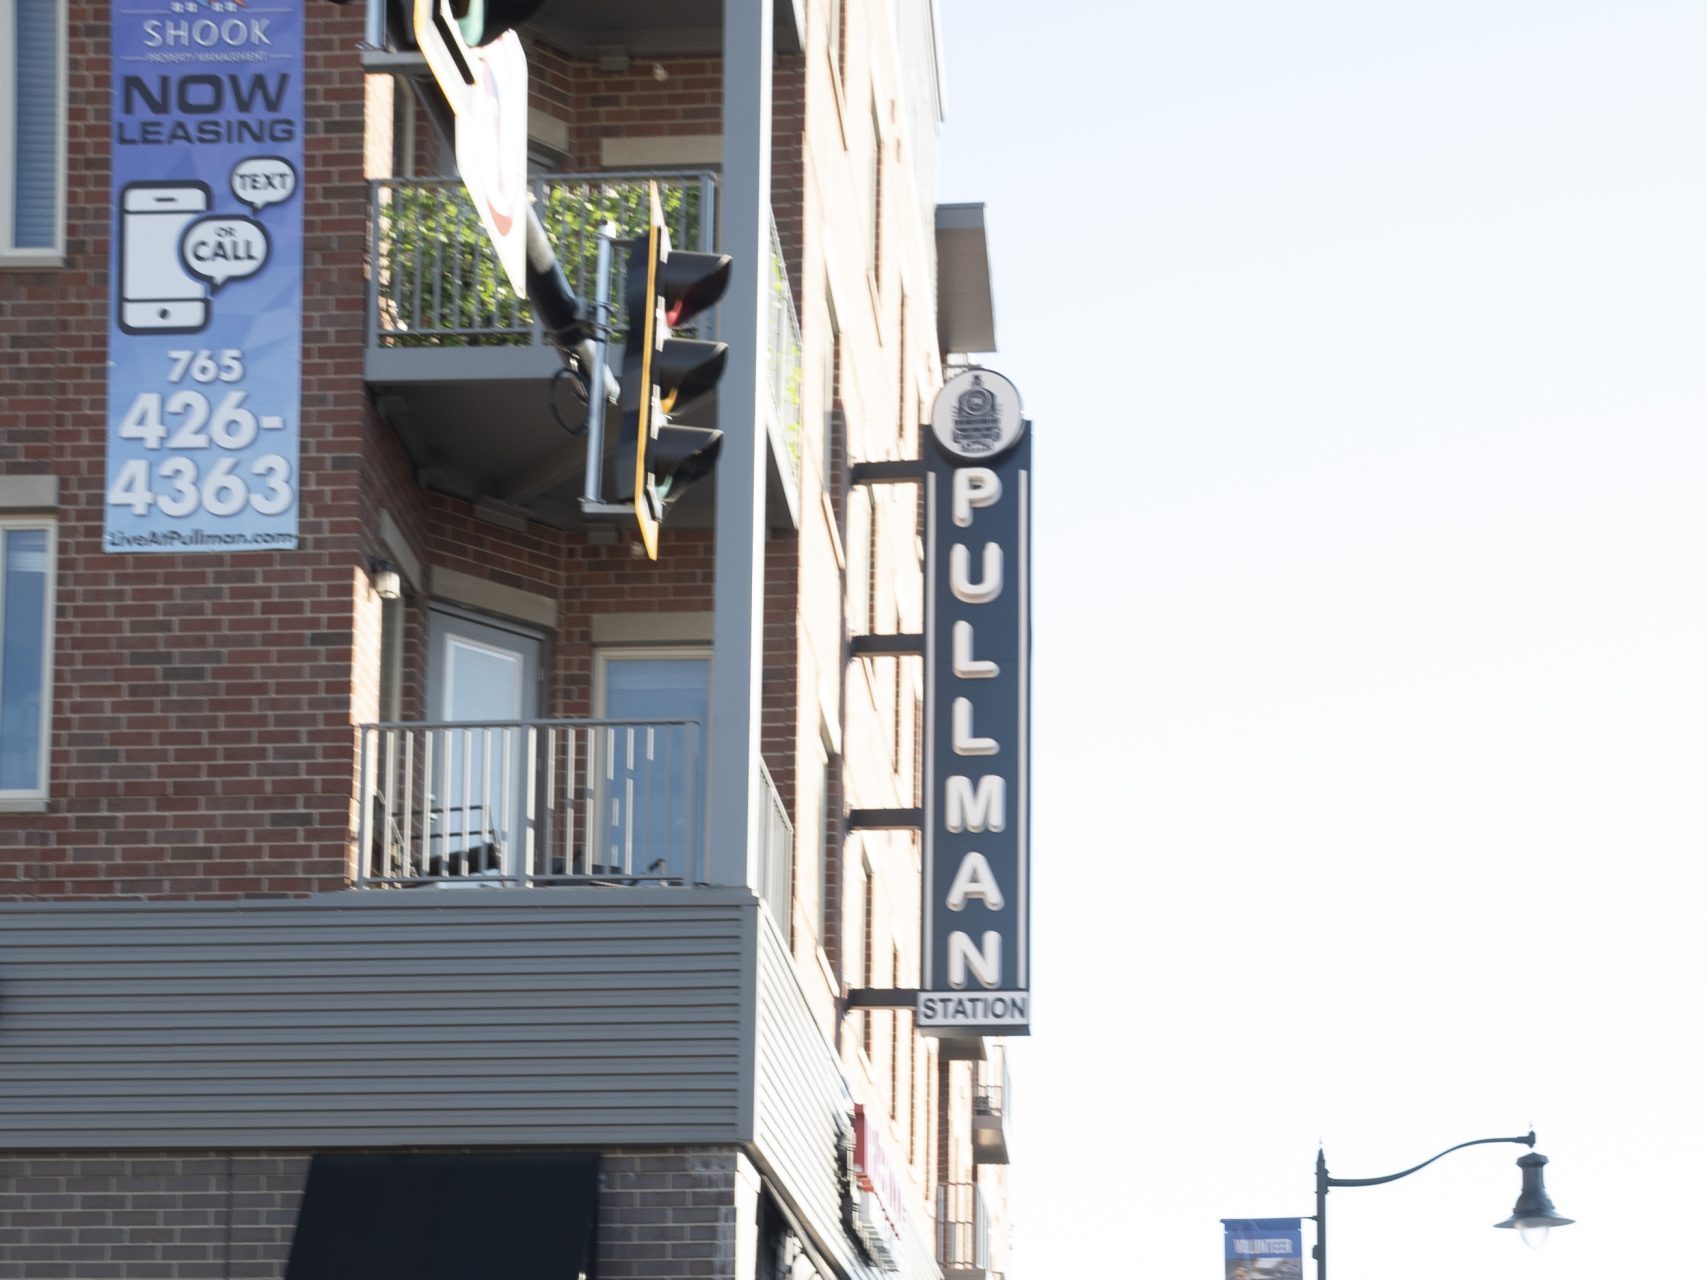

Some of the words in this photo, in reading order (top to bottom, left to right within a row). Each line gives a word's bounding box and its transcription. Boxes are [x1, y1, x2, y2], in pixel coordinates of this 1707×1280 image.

[142, 18, 272, 47] SHOOK
[122, 72, 289, 115] NOW
[116, 118, 296, 145] LEASING
[237, 172, 289, 191] TEXT
[215, 226, 237, 238] OR
[192, 240, 259, 262] CALL
[166, 349, 244, 383] 765
[118, 389, 286, 450] 426-
[108, 454, 294, 518] 4363
[110, 528, 297, 547] LiveAtPullman.com
[945, 466, 1007, 989] PULLMAN
[923, 997, 1027, 1019] STATION
[1233, 1238, 1294, 1254] VOLUNTEER
